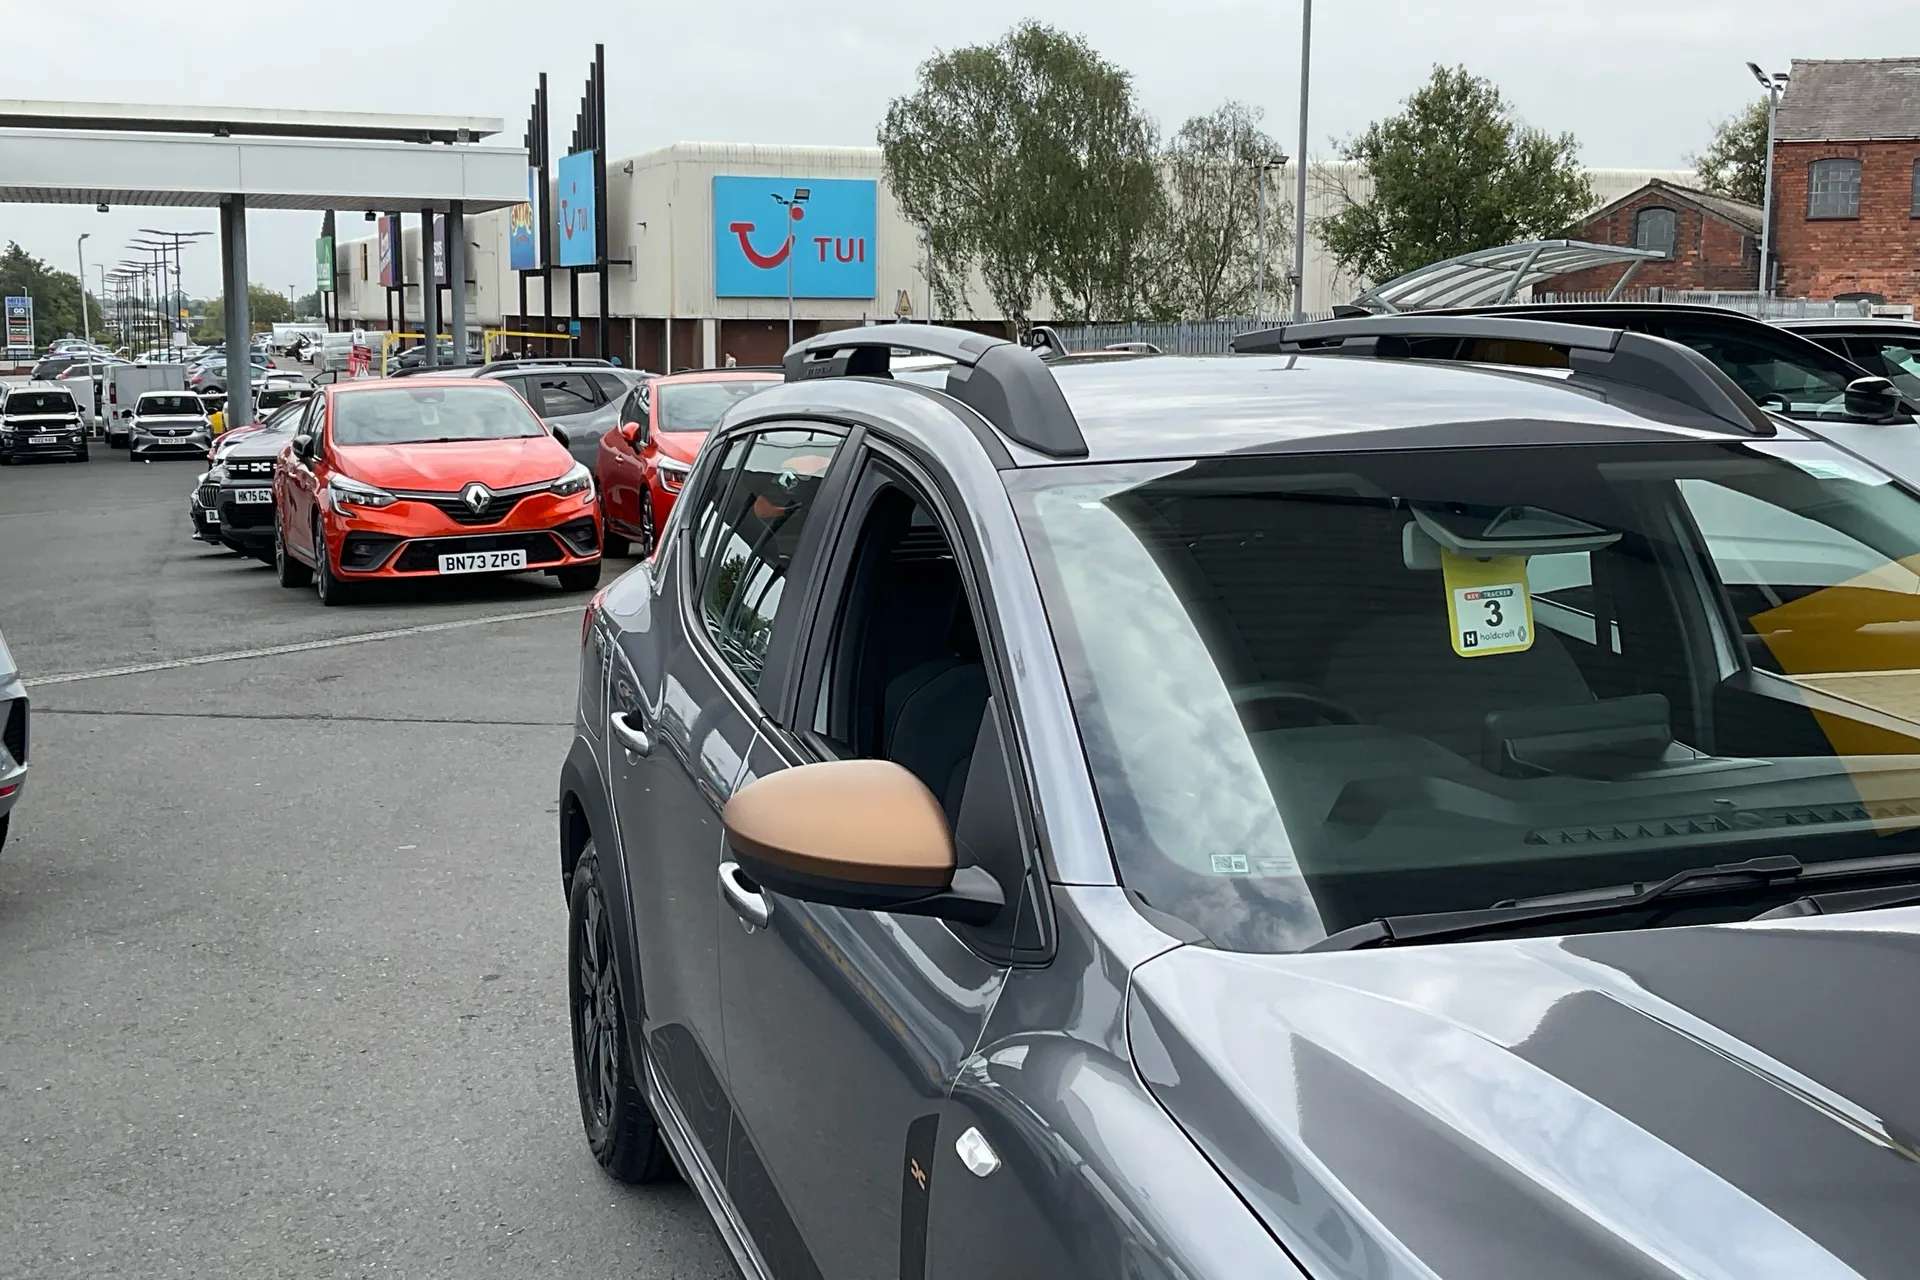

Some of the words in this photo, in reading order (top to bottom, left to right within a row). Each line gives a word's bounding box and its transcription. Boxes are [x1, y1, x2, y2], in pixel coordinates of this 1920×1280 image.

[813, 237, 865, 263] TUI
[238, 491, 257, 502] HK75
[445, 555, 486, 571] BN73
[490, 553, 520, 568] ZPG
[1483, 589, 1511, 598] TRACKER
[1483, 600, 1504, 627] 3
[1480, 629, 1515, 641] holdcroft
